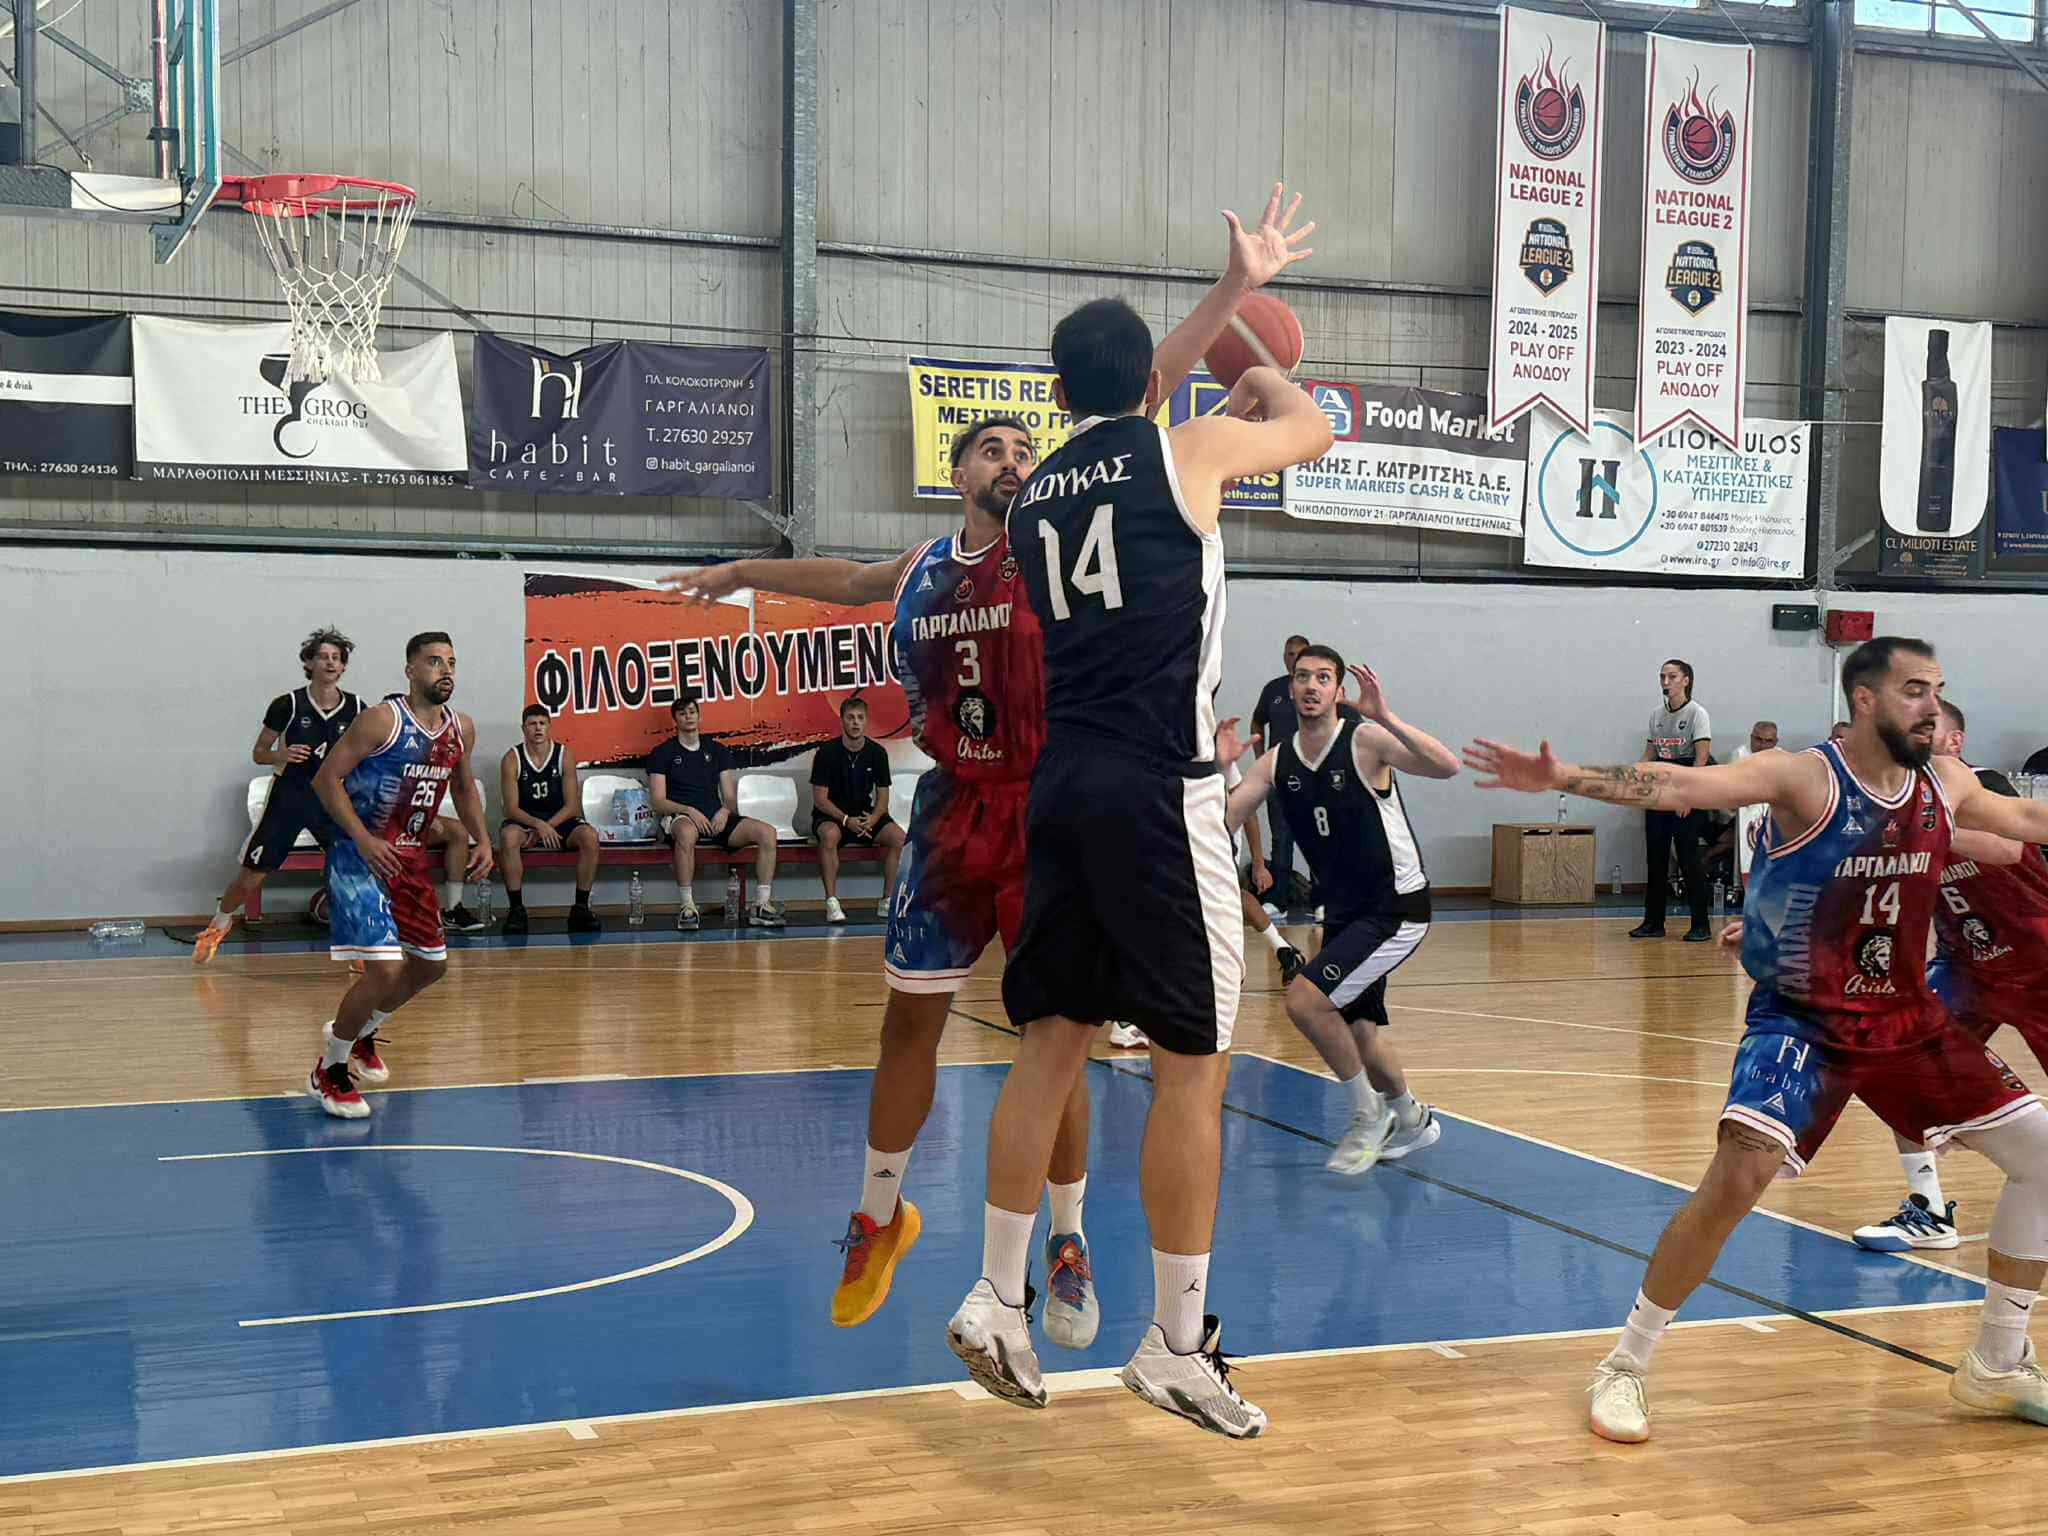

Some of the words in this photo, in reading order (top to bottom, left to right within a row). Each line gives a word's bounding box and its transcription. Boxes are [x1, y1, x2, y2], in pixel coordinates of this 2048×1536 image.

[1510, 163, 1585, 188] NATIONAL
[1510, 183, 1570, 205] LEAGUE
[1575, 191, 1583, 207] 2
[1656, 189, 1734, 211] NATIONAL
[1656, 208, 1720, 228] LEAGUE
[1723, 214, 1732, 230] 2
[1528, 234, 1567, 248] NATIONAL
[1522, 247, 1562, 266] LEAGUE
[1564, 251, 1572, 268] 2
[1675, 255, 1715, 270] NATIONAL
[1668, 269, 1711, 287] LEAGUE
[1712, 273, 1720, 288] 2
[1508, 320, 1537, 336] 2024
[1548, 324, 1578, 340] 2025
[1510, 341, 1545, 358] PLAY
[1548, 344, 1575, 360] OFF
[1656, 339, 1685, 355] 2023
[1696, 342, 1726, 358] 2024
[1513, 363, 1571, 381] ΑΝΟΔΟΥ
[1657, 360, 1692, 376] PLAY
[1695, 362, 1724, 378] OFF
[14, 380, 33, 391] drink
[665, 376, 744, 388] ΚΟΛΟΚΟΤΡΩΝΗ
[919, 374, 1012, 401] SERETIS
[1660, 381, 1719, 398] ΑΝΟΔΟΥ
[238, 396, 286, 415] THE
[304, 398, 367, 420] GROG
[645, 399, 755, 416] ΓΑΡΓΑΛΙΑΝΟΙ
[1365, 401, 1423, 430] Food
[306, 417, 348, 428] cocktail
[353, 419, 368, 429] bar
[663, 428, 708, 444] 27630
[712, 430, 754, 446] 29257
[1658, 429, 1802, 455] ILIOPULOS
[490, 429, 617, 467] habit
[4, 461, 37, 473] ΤΗΛ.:
[40, 462, 78, 474] 27630
[80, 464, 118, 475] 24136
[661, 457, 756, 475] habit_gargalianoi
[1687, 454, 1759, 472] ΜΕΣΙΤΙΚΕΣ
[1763, 459, 1773, 473] &
[153, 466, 260, 481] ΜΑΡΑΘΟΠΟΛΗ
[264, 469, 350, 483] ΜΕΣΣΗΝΙΑΣ
[376, 473, 406, 485] 2763
[409, 474, 454, 486] 061855
[576, 471, 617, 483] BAR
[1020, 453, 1132, 508] ΔΟΥΚΑΣ
[1358, 459, 1371, 476] Γ.
[1377, 461, 1475, 486] ΚΑΤΡΙΤΣΗΣ
[1479, 473, 1511, 492] Α.Ε.
[1664, 470, 1794, 489] ΚΑΤΑΣΚΕΥΑΣΤΙΚΕΣ
[1296, 475, 1342, 490] SUPER
[1345, 478, 1406, 494] MARKETS
[1410, 483, 1449, 498] CASH
[1453, 487, 1464, 500] &
[1469, 489, 1510, 506] CARRY
[1691, 487, 1768, 504] ΥΠΗΡΕΣΙΕΣ
[1294, 503, 1373, 518] ΝΙΚΟΛΟΠΟΥΛΟΥ
[1456, 517, 1512, 531] ΜΕΣΣΗΝΙΑΣ
[1942, 540, 1978, 552] ESTATE
[1038, 503, 1124, 621] 14
[1670, 555, 1721, 569] www.ire.gr
[1740, 557, 1791, 571] info@ire.gr
[955, 639, 982, 687] 3
[314, 741, 328, 759] 4
[411, 780, 437, 807] 26
[532, 781, 549, 800] 33
[1313, 806, 1330, 837] 8
[250, 845, 263, 864] 4
[1859, 882, 1901, 925] 14
[1940, 886, 1970, 914] 6
